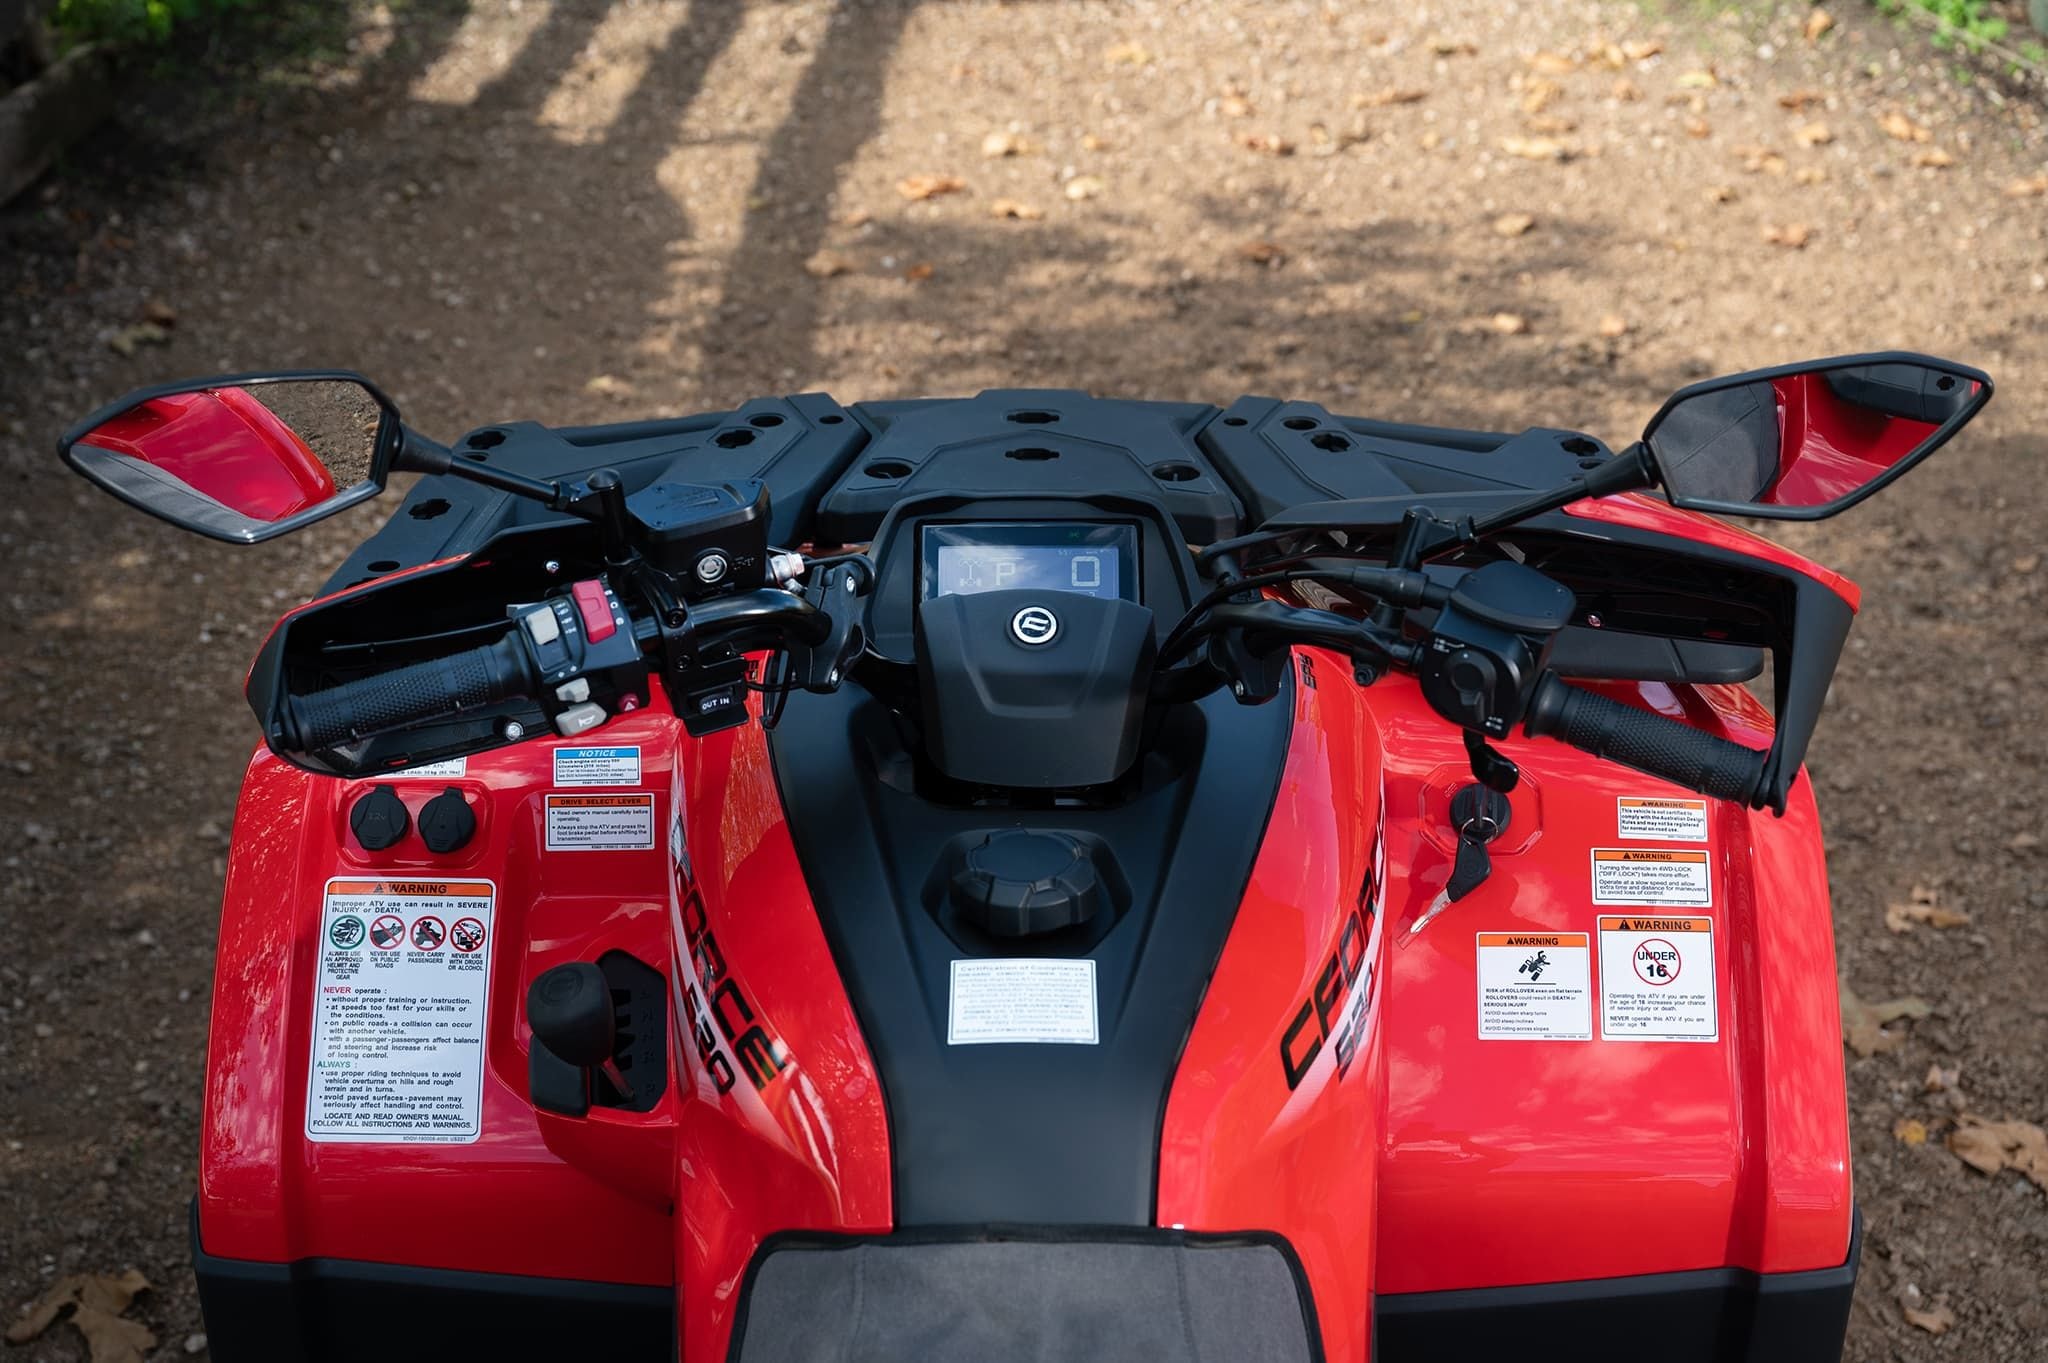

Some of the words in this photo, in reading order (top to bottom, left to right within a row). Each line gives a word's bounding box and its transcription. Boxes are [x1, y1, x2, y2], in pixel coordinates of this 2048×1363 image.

[995, 562, 1015, 586] P
[702, 699, 717, 711] OUT
[719, 697, 730, 706] IN
[389, 883, 447, 894] WARNING
[1634, 921, 1692, 930] WARNING
[1514, 937, 1558, 946] WARNING
[1637, 952, 1677, 961] UNDER
[1646, 964, 1668, 977] 16
[431, 997, 472, 1005] instruction.
[391, 1071, 428, 1079] techniques
[384, 1102, 415, 1110] handling
